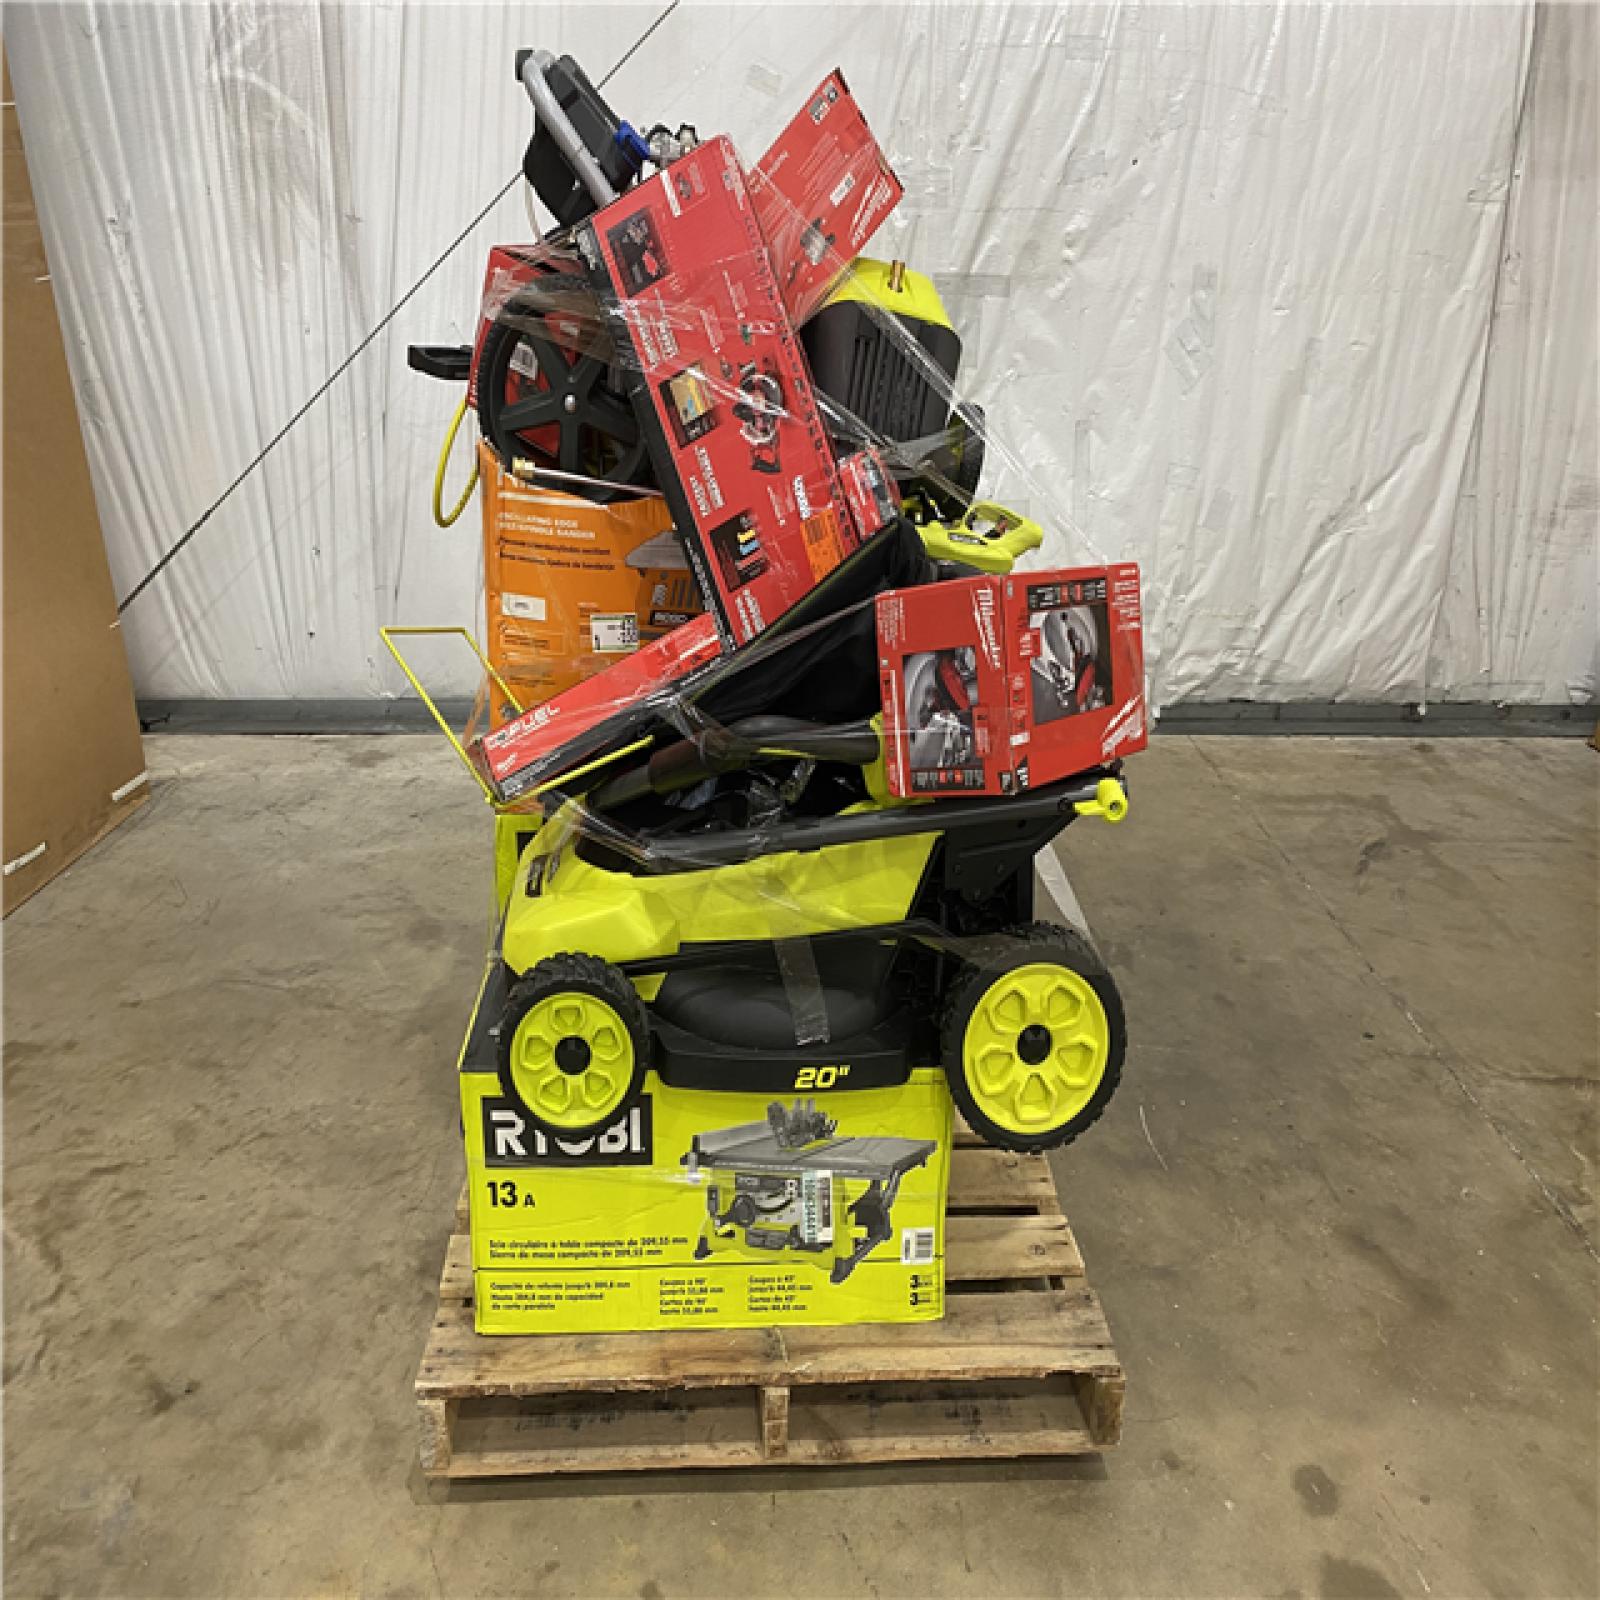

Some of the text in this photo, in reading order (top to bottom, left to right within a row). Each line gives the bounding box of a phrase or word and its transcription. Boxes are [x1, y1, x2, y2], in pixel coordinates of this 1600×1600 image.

[794, 1065, 850, 1089] 20"
[486, 1181, 536, 1208] 13 A
[910, 1275, 919, 1288] 3
[910, 1292, 919, 1305] 3
